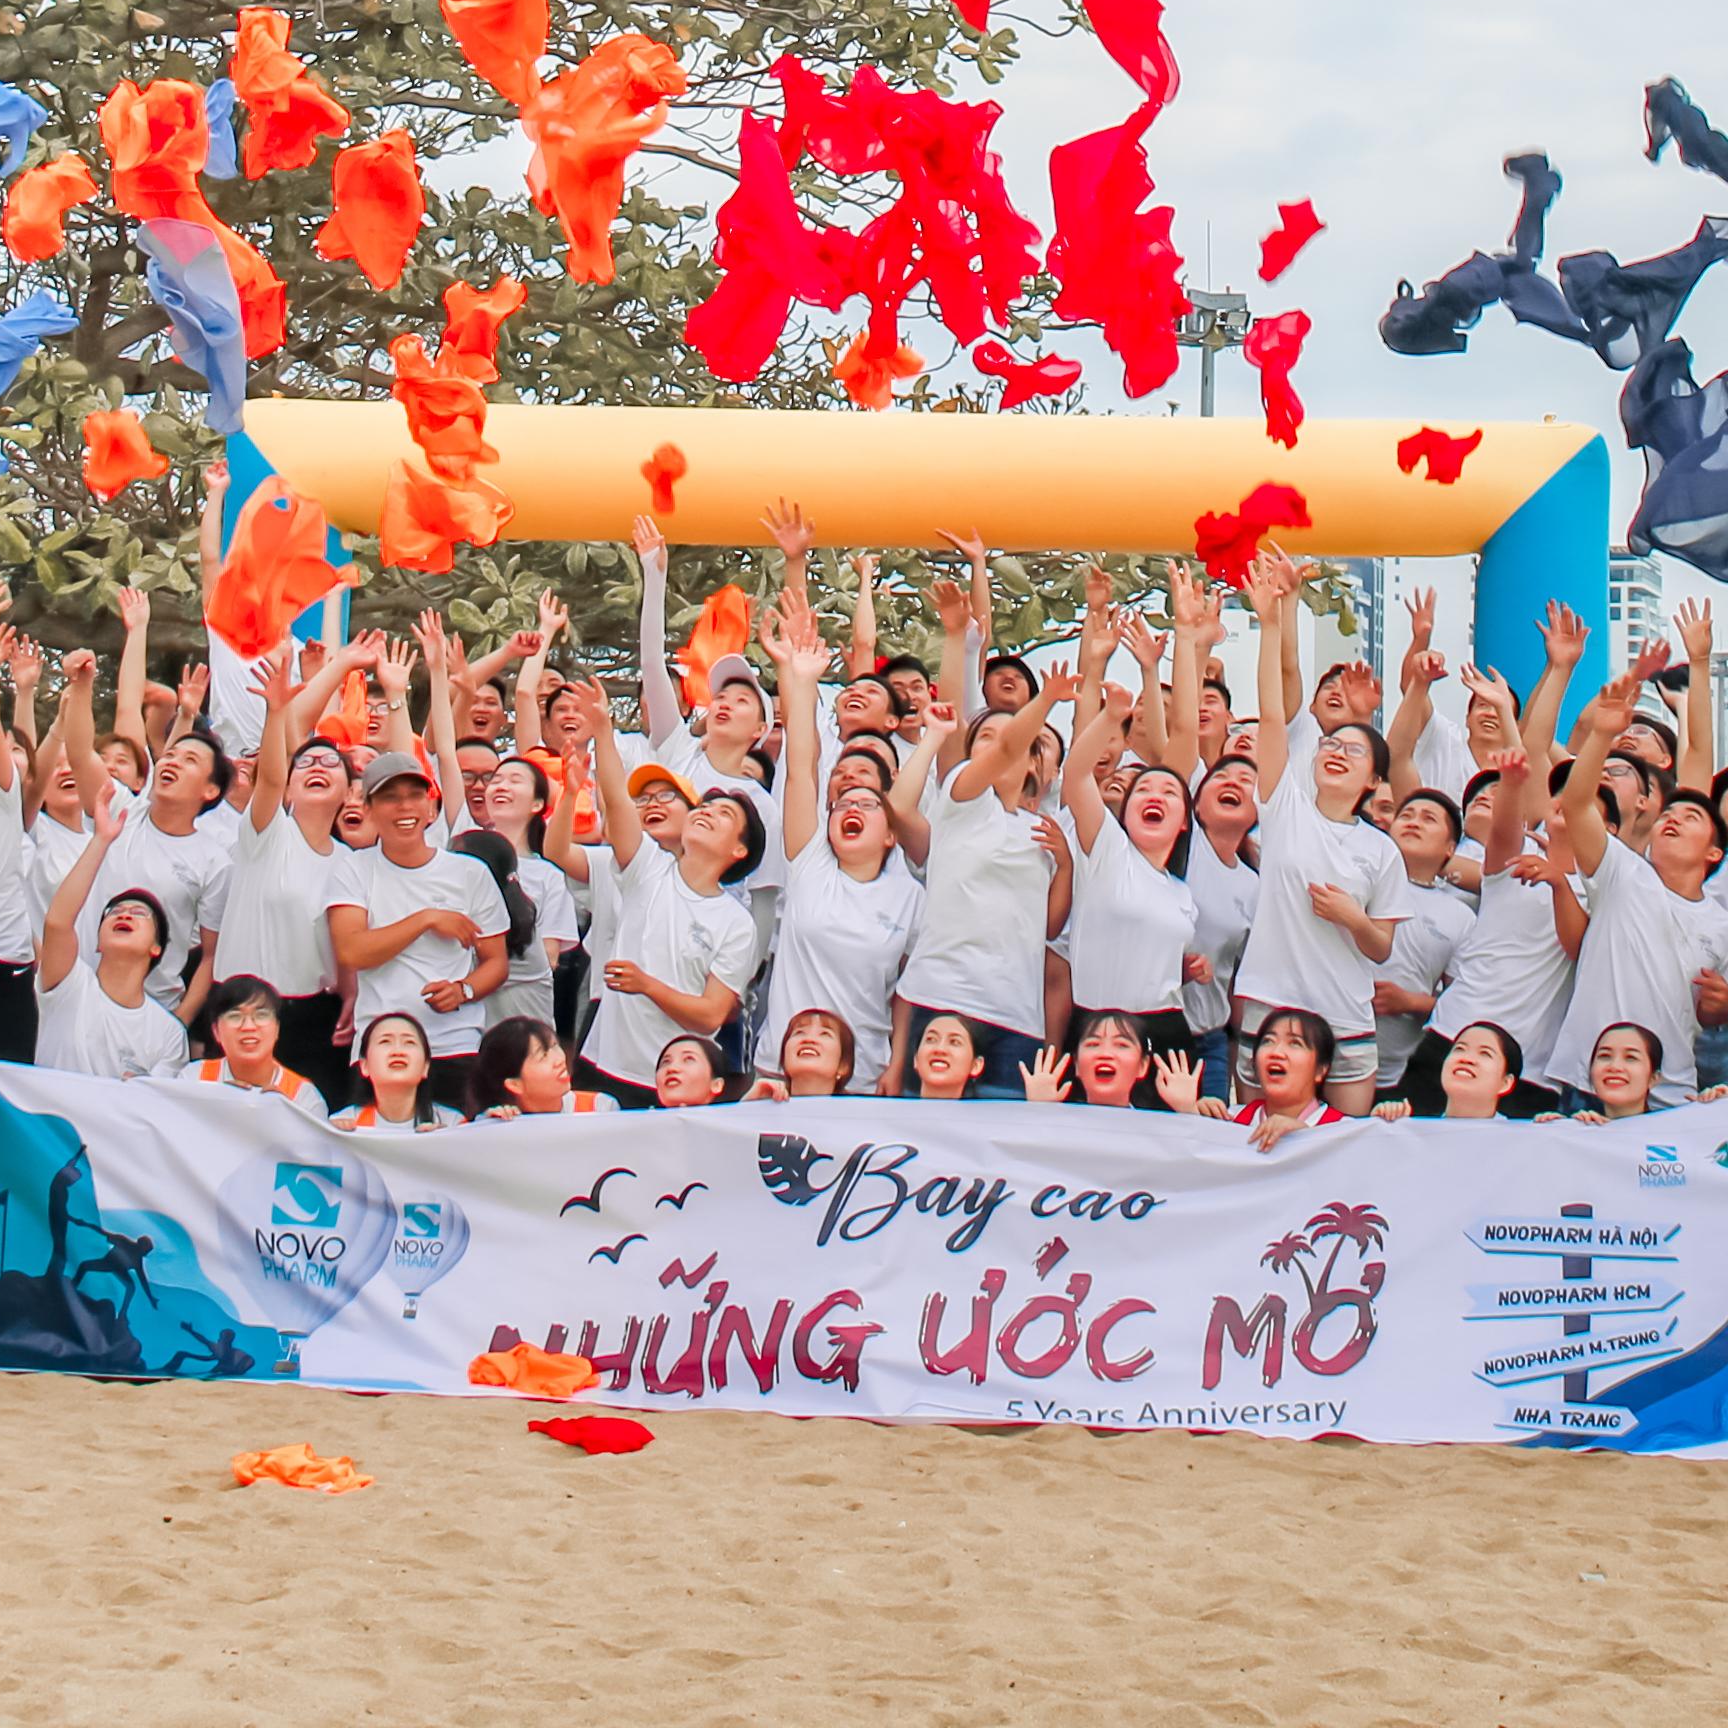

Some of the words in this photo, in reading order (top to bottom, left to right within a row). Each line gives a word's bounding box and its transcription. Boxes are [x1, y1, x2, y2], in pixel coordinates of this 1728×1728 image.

[1638, 1162, 1685, 1177] NOVO
[1639, 1175, 1686, 1189] PHARM
[807, 1143, 1016, 1253] Bay
[1030, 1184, 1167, 1221] cao
[255, 1227, 347, 1262] NOVO
[394, 1239, 445, 1256] NOVO
[1484, 1224, 1592, 1245] NOVOPHARM
[1599, 1225, 1623, 1246] HÀ
[1630, 1226, 1658, 1249] NỘI
[260, 1256, 339, 1288] PHARM
[395, 1253, 440, 1269] PHARM
[1498, 1286, 1607, 1307] NOVOPHARM
[1614, 1284, 1651, 1301] HCM
[918, 1236, 1157, 1386] ƯỚC
[1202, 1261, 1387, 1391] MƠ
[1483, 1344, 1584, 1375] NOVOPHARM
[1005, 1400, 1024, 1418] 5
[1137, 1399, 1348, 1427] Anniversary
[1513, 1407, 1552, 1425] NHA
[1559, 1411, 1622, 1428] TRANG
